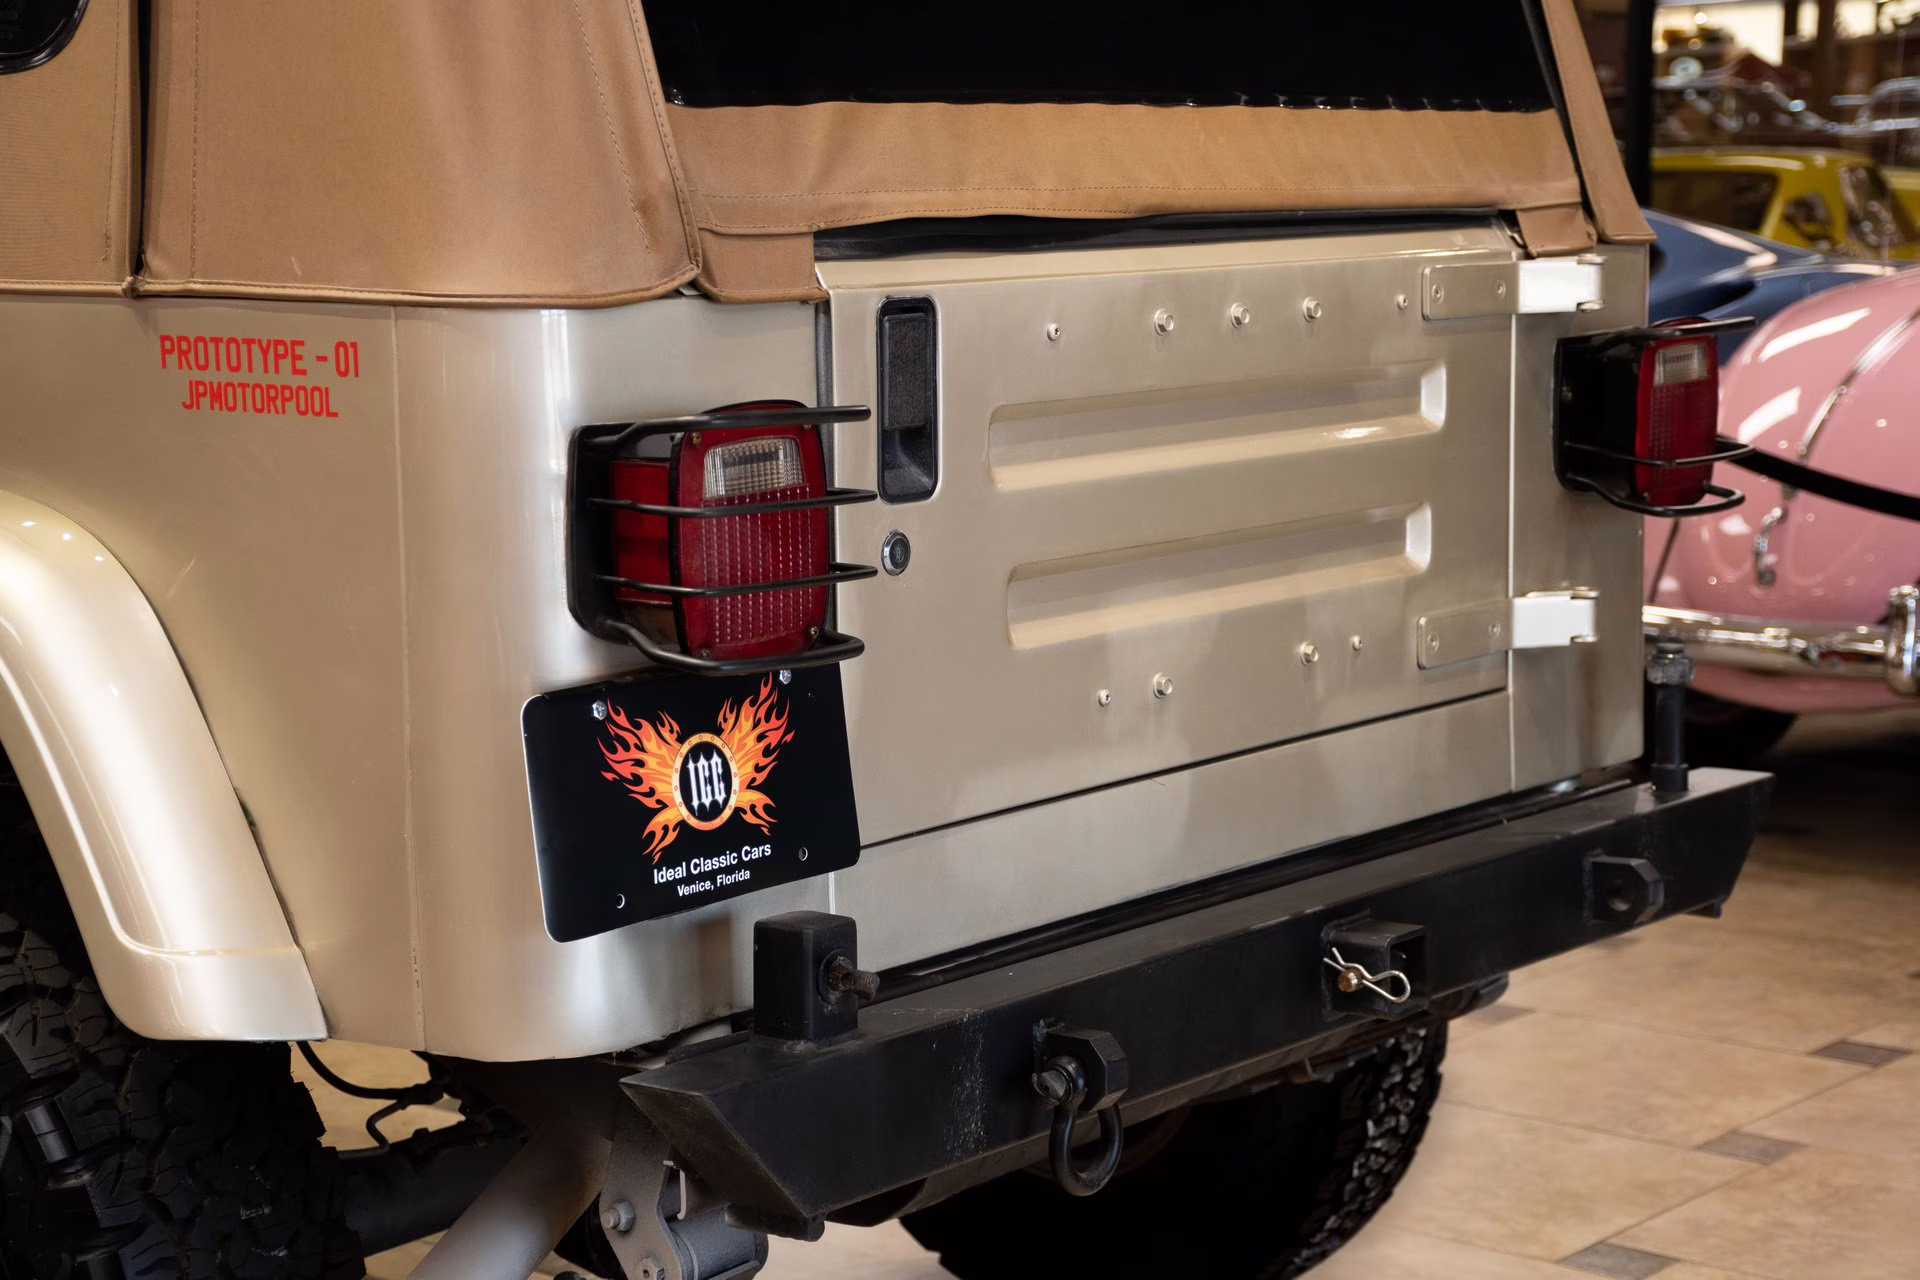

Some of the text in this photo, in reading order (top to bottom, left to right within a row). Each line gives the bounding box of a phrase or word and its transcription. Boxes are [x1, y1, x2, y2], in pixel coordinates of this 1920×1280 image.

[160, 335, 308, 376] PROTOTYPE
[334, 341, 359, 378] 01
[182, 380, 339, 418] JPMOTORPOOL
[653, 844, 772, 885] Ideal Classic Cars
[677, 868, 751, 897] Venice, Florida
